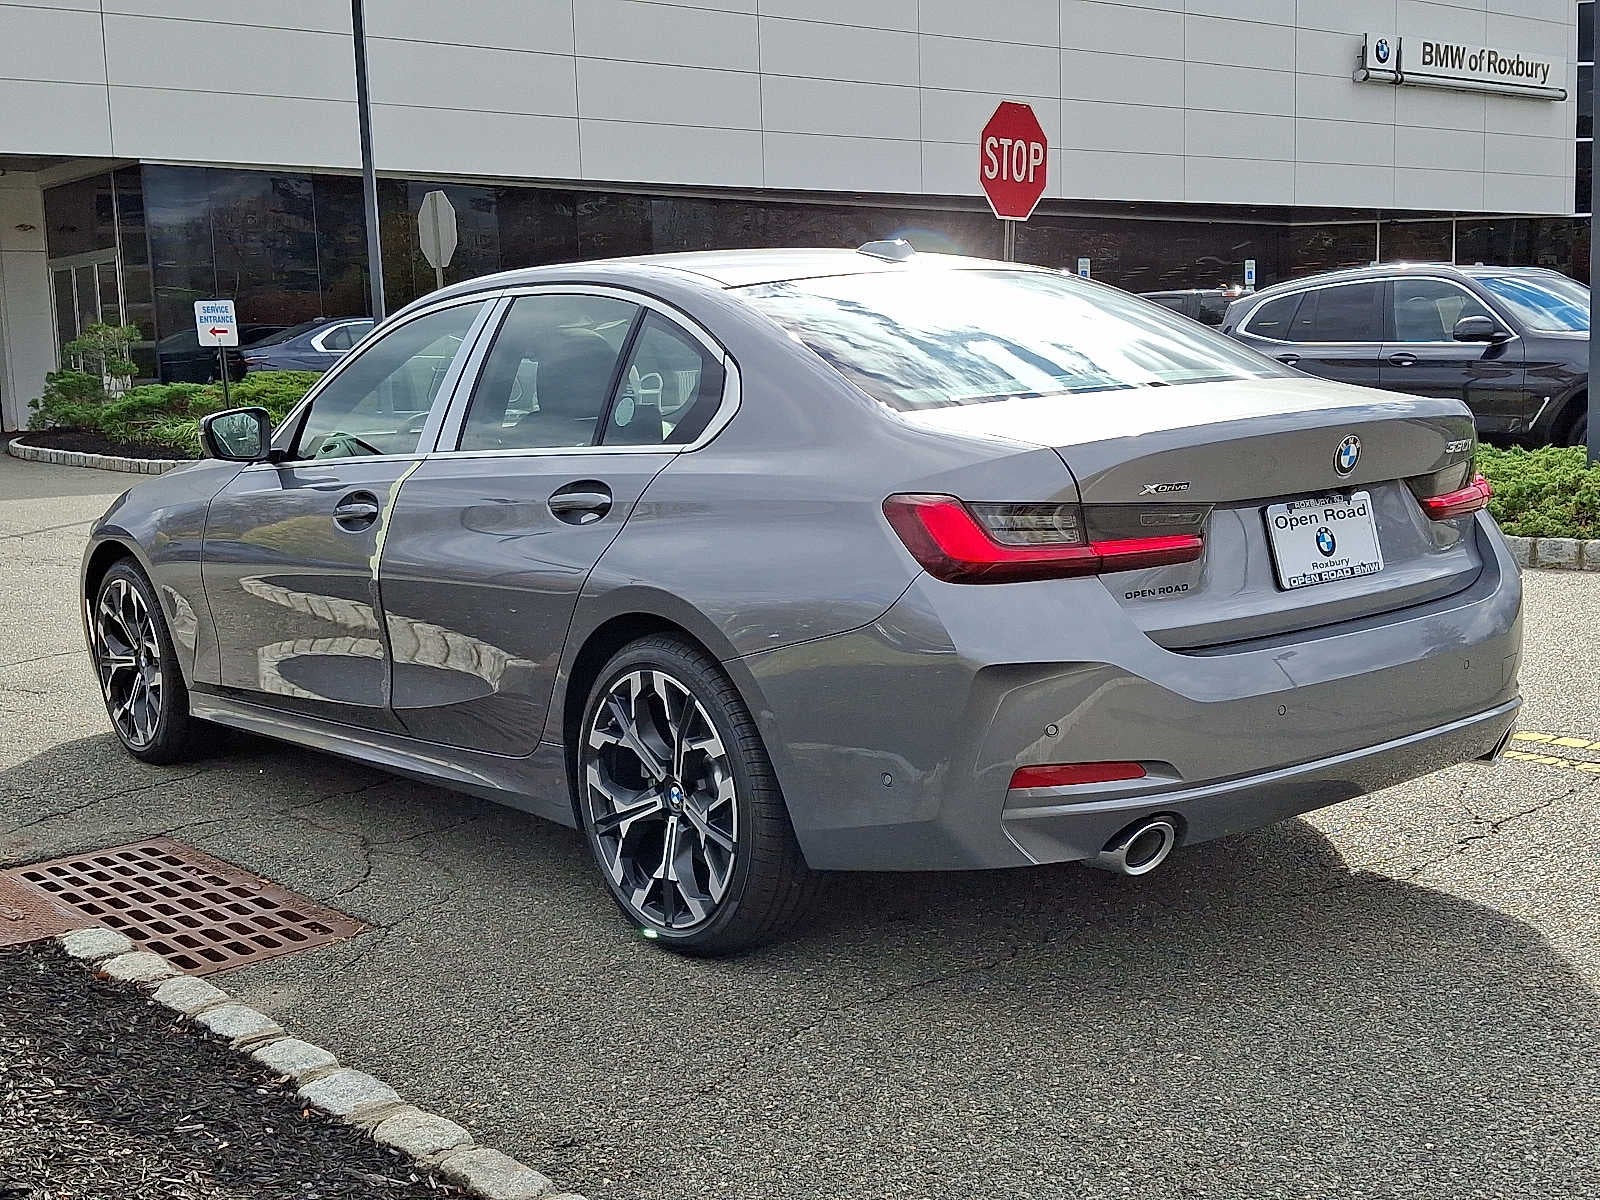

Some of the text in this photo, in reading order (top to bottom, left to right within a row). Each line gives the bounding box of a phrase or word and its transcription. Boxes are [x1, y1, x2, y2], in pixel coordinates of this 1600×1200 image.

[1422, 41, 1551, 85] BMW of Roxbury
[984, 136, 1044, 183] STOP
[200, 315, 234, 323] ENTRANCE
[202, 305, 229, 313] SERVICE
[1274, 503, 1367, 531] Open Road
[1290, 561, 1380, 586] OPEN ROAD BMW
[1311, 557, 1350, 571] Roxbury
[1125, 583, 1189, 600] OPEN ROAD
